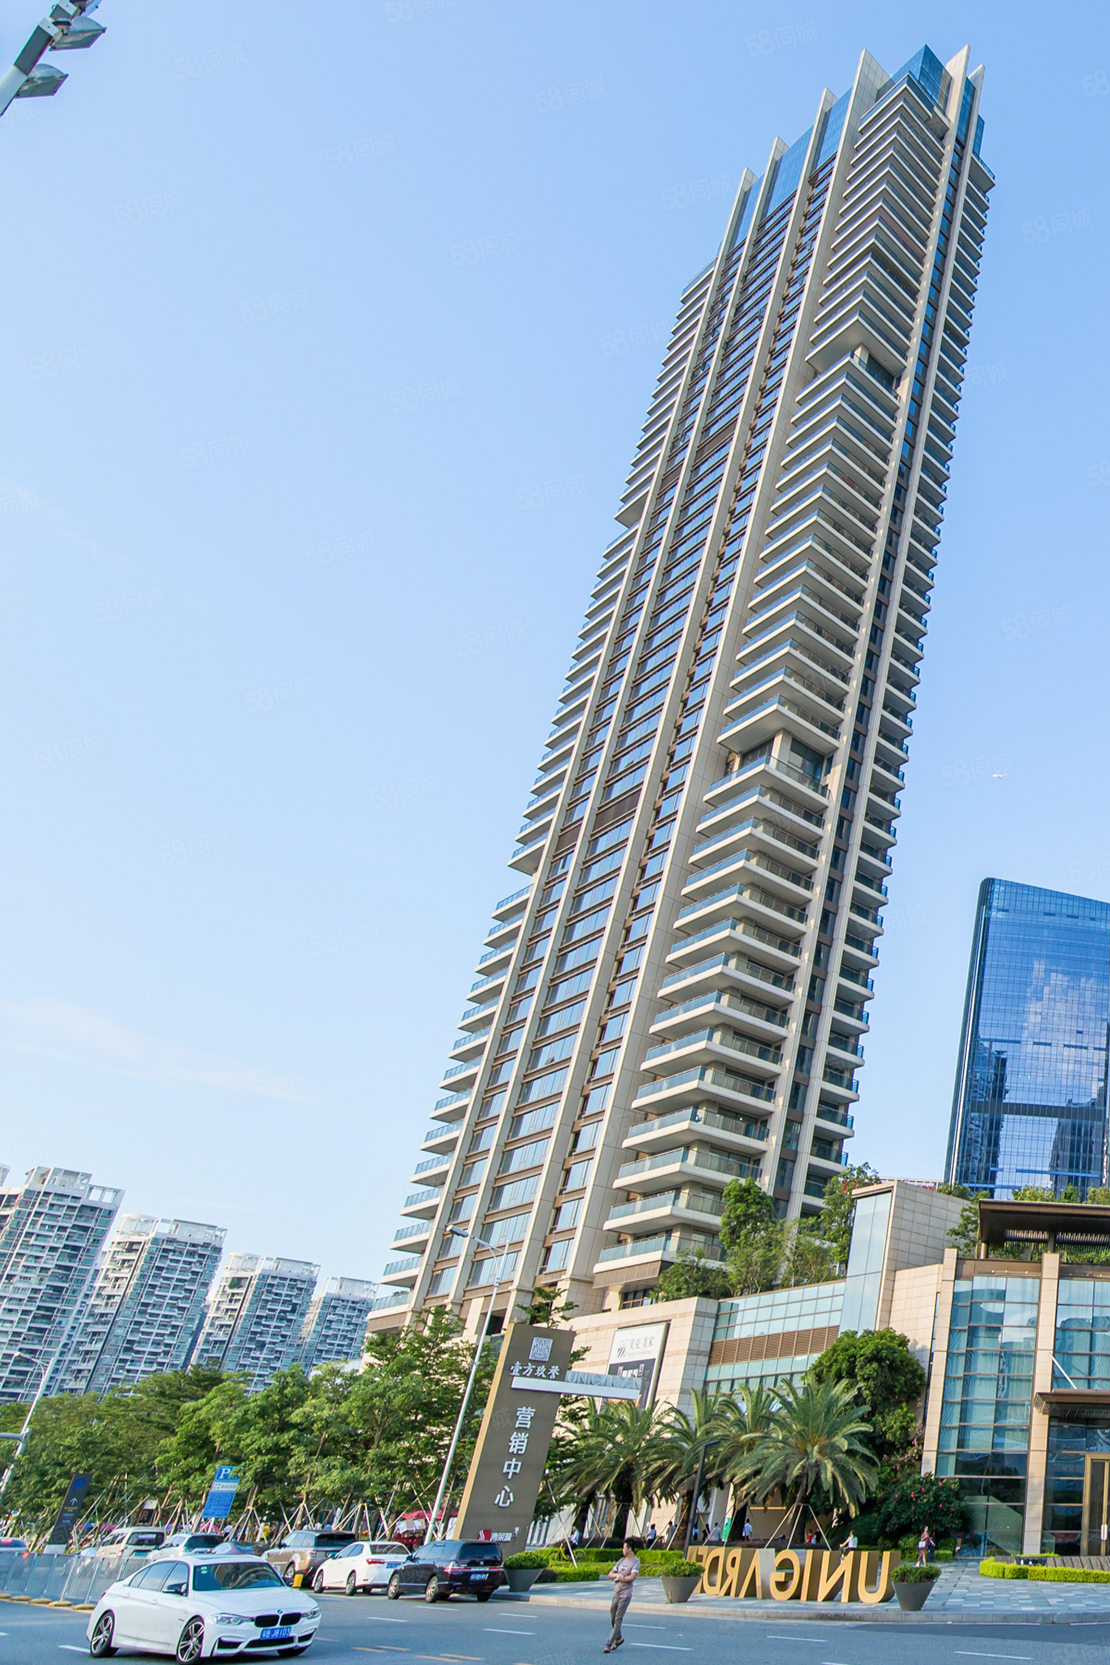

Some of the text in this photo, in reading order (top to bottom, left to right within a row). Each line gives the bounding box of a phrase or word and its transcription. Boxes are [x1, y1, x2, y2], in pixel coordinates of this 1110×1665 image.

[509, 1361, 560, 1379] 壹方玖誉
[494, 1406, 536, 1508] 营销中心
[219, 1468, 230, 1479] P
[73, 1478, 86, 1491] P
